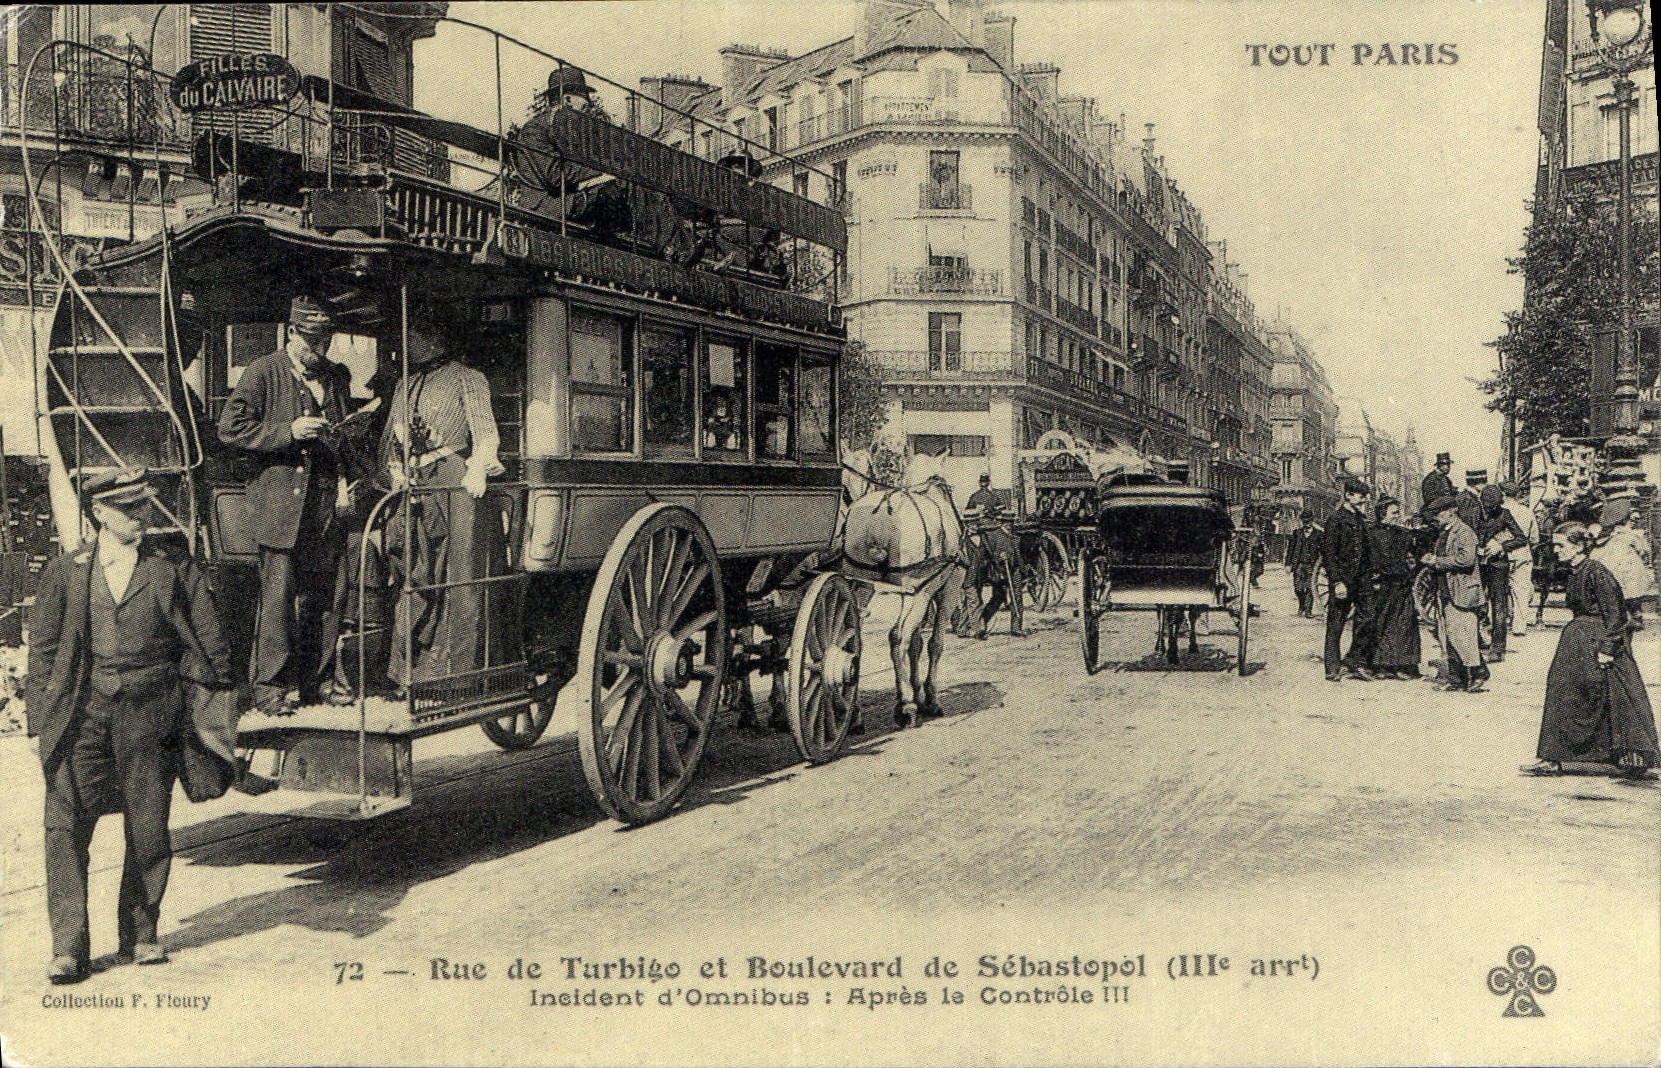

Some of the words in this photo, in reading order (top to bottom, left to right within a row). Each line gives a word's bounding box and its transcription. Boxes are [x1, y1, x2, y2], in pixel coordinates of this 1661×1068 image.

[199, 54, 270, 77] FILLES
[179, 87, 200, 109] du
[202, 75, 287, 106] CALVAIRE
